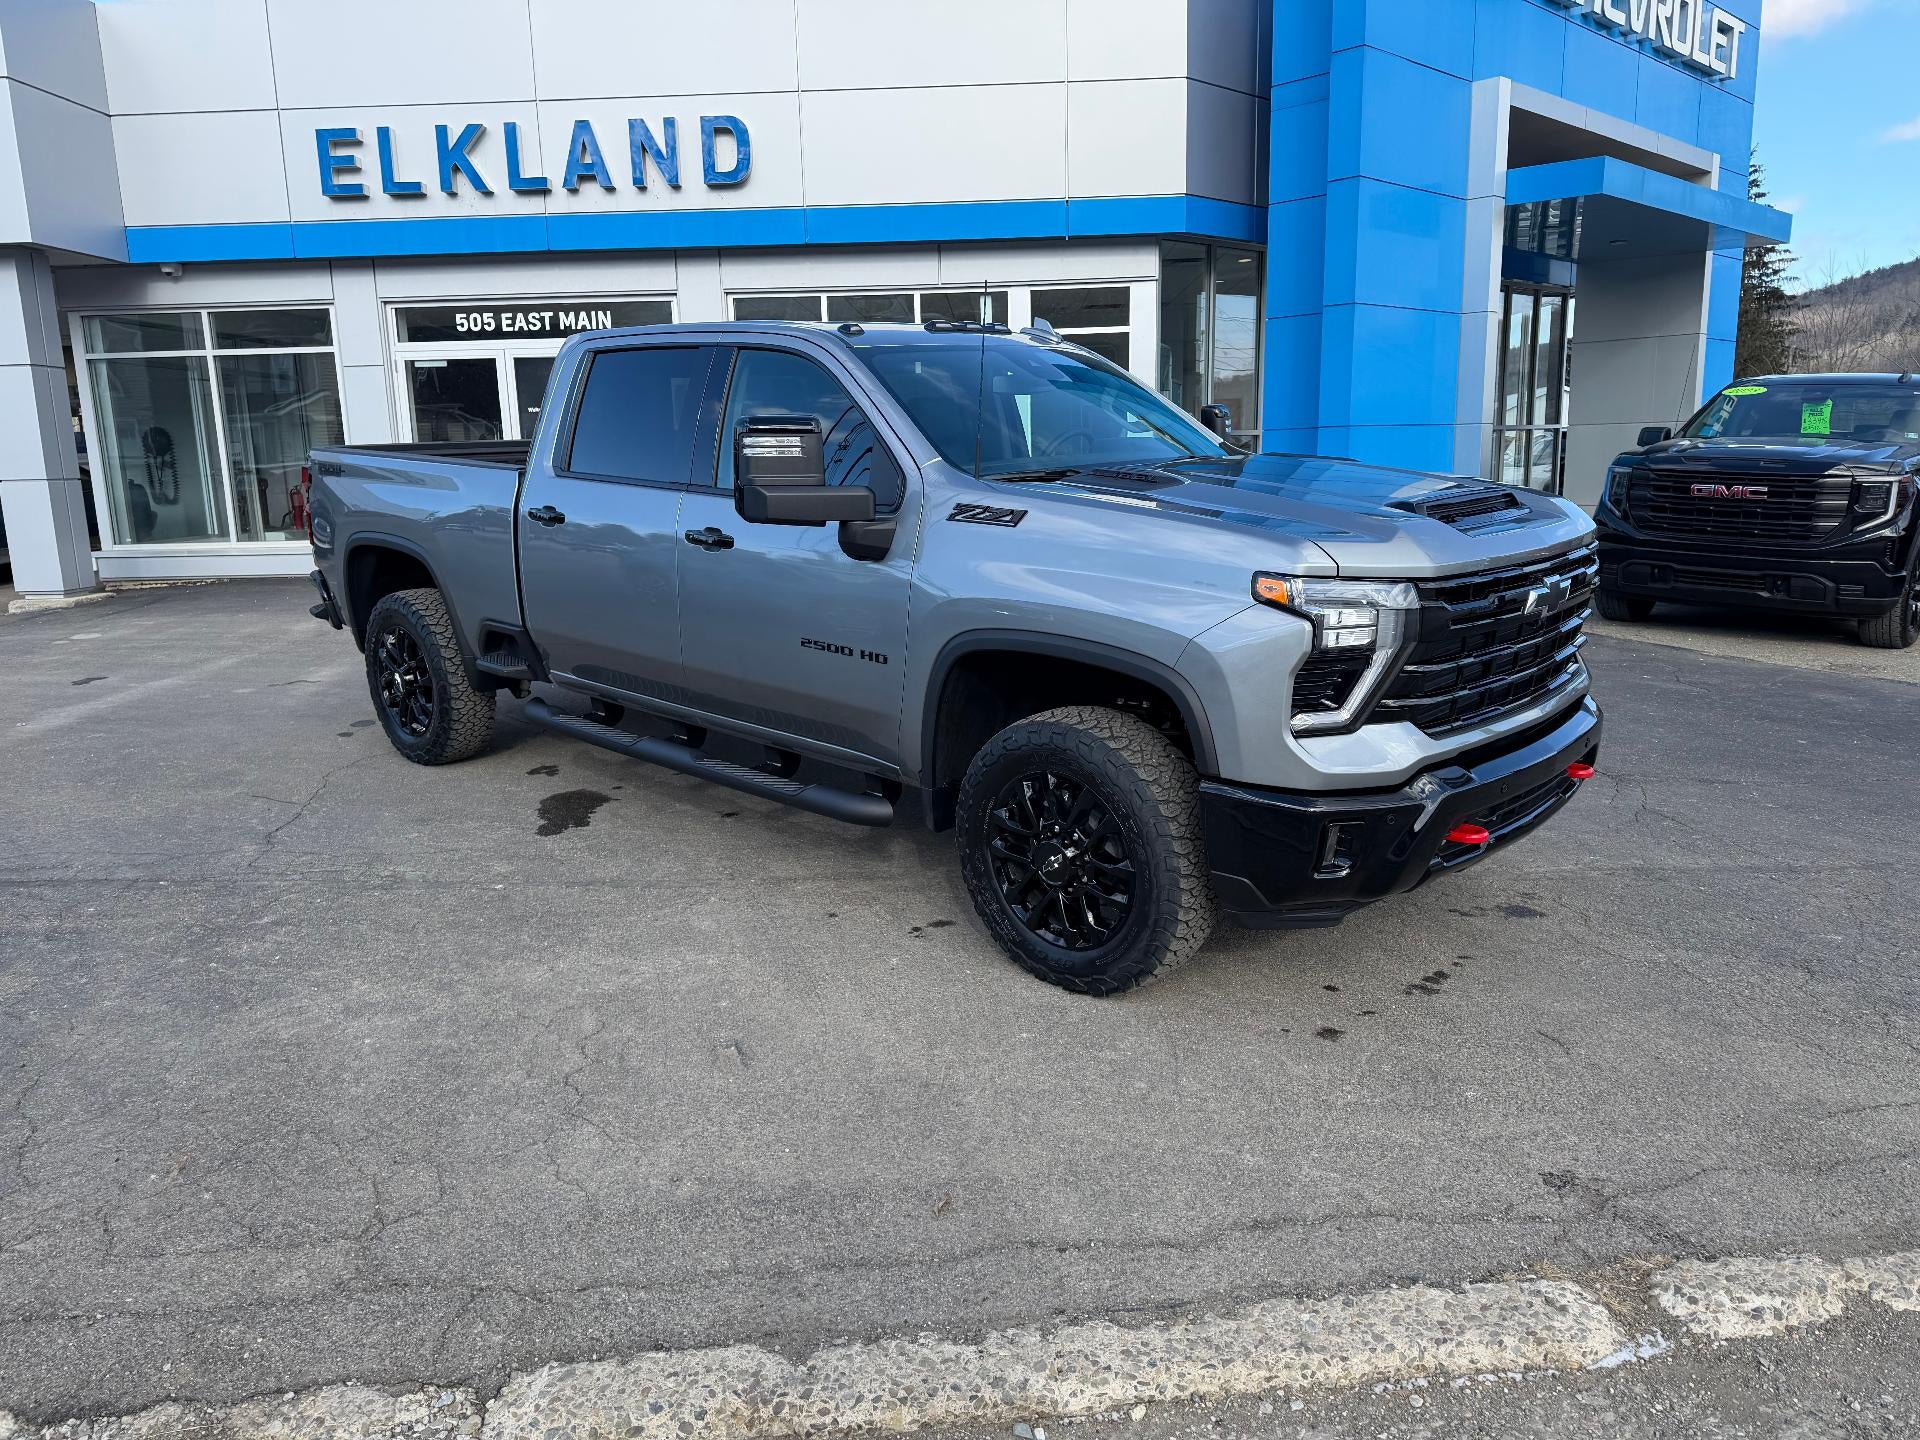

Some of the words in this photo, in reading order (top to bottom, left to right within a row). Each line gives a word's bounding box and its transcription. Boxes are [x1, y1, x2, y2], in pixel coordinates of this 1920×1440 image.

[315, 115, 753, 198] ELKLAND
[455, 312, 496, 332] 505
[501, 311, 554, 331] EAST
[558, 310, 612, 330] MAIN
[1690, 483, 1768, 499] GMC
[800, 637, 854, 657] 2500
[860, 648, 888, 665] HD
